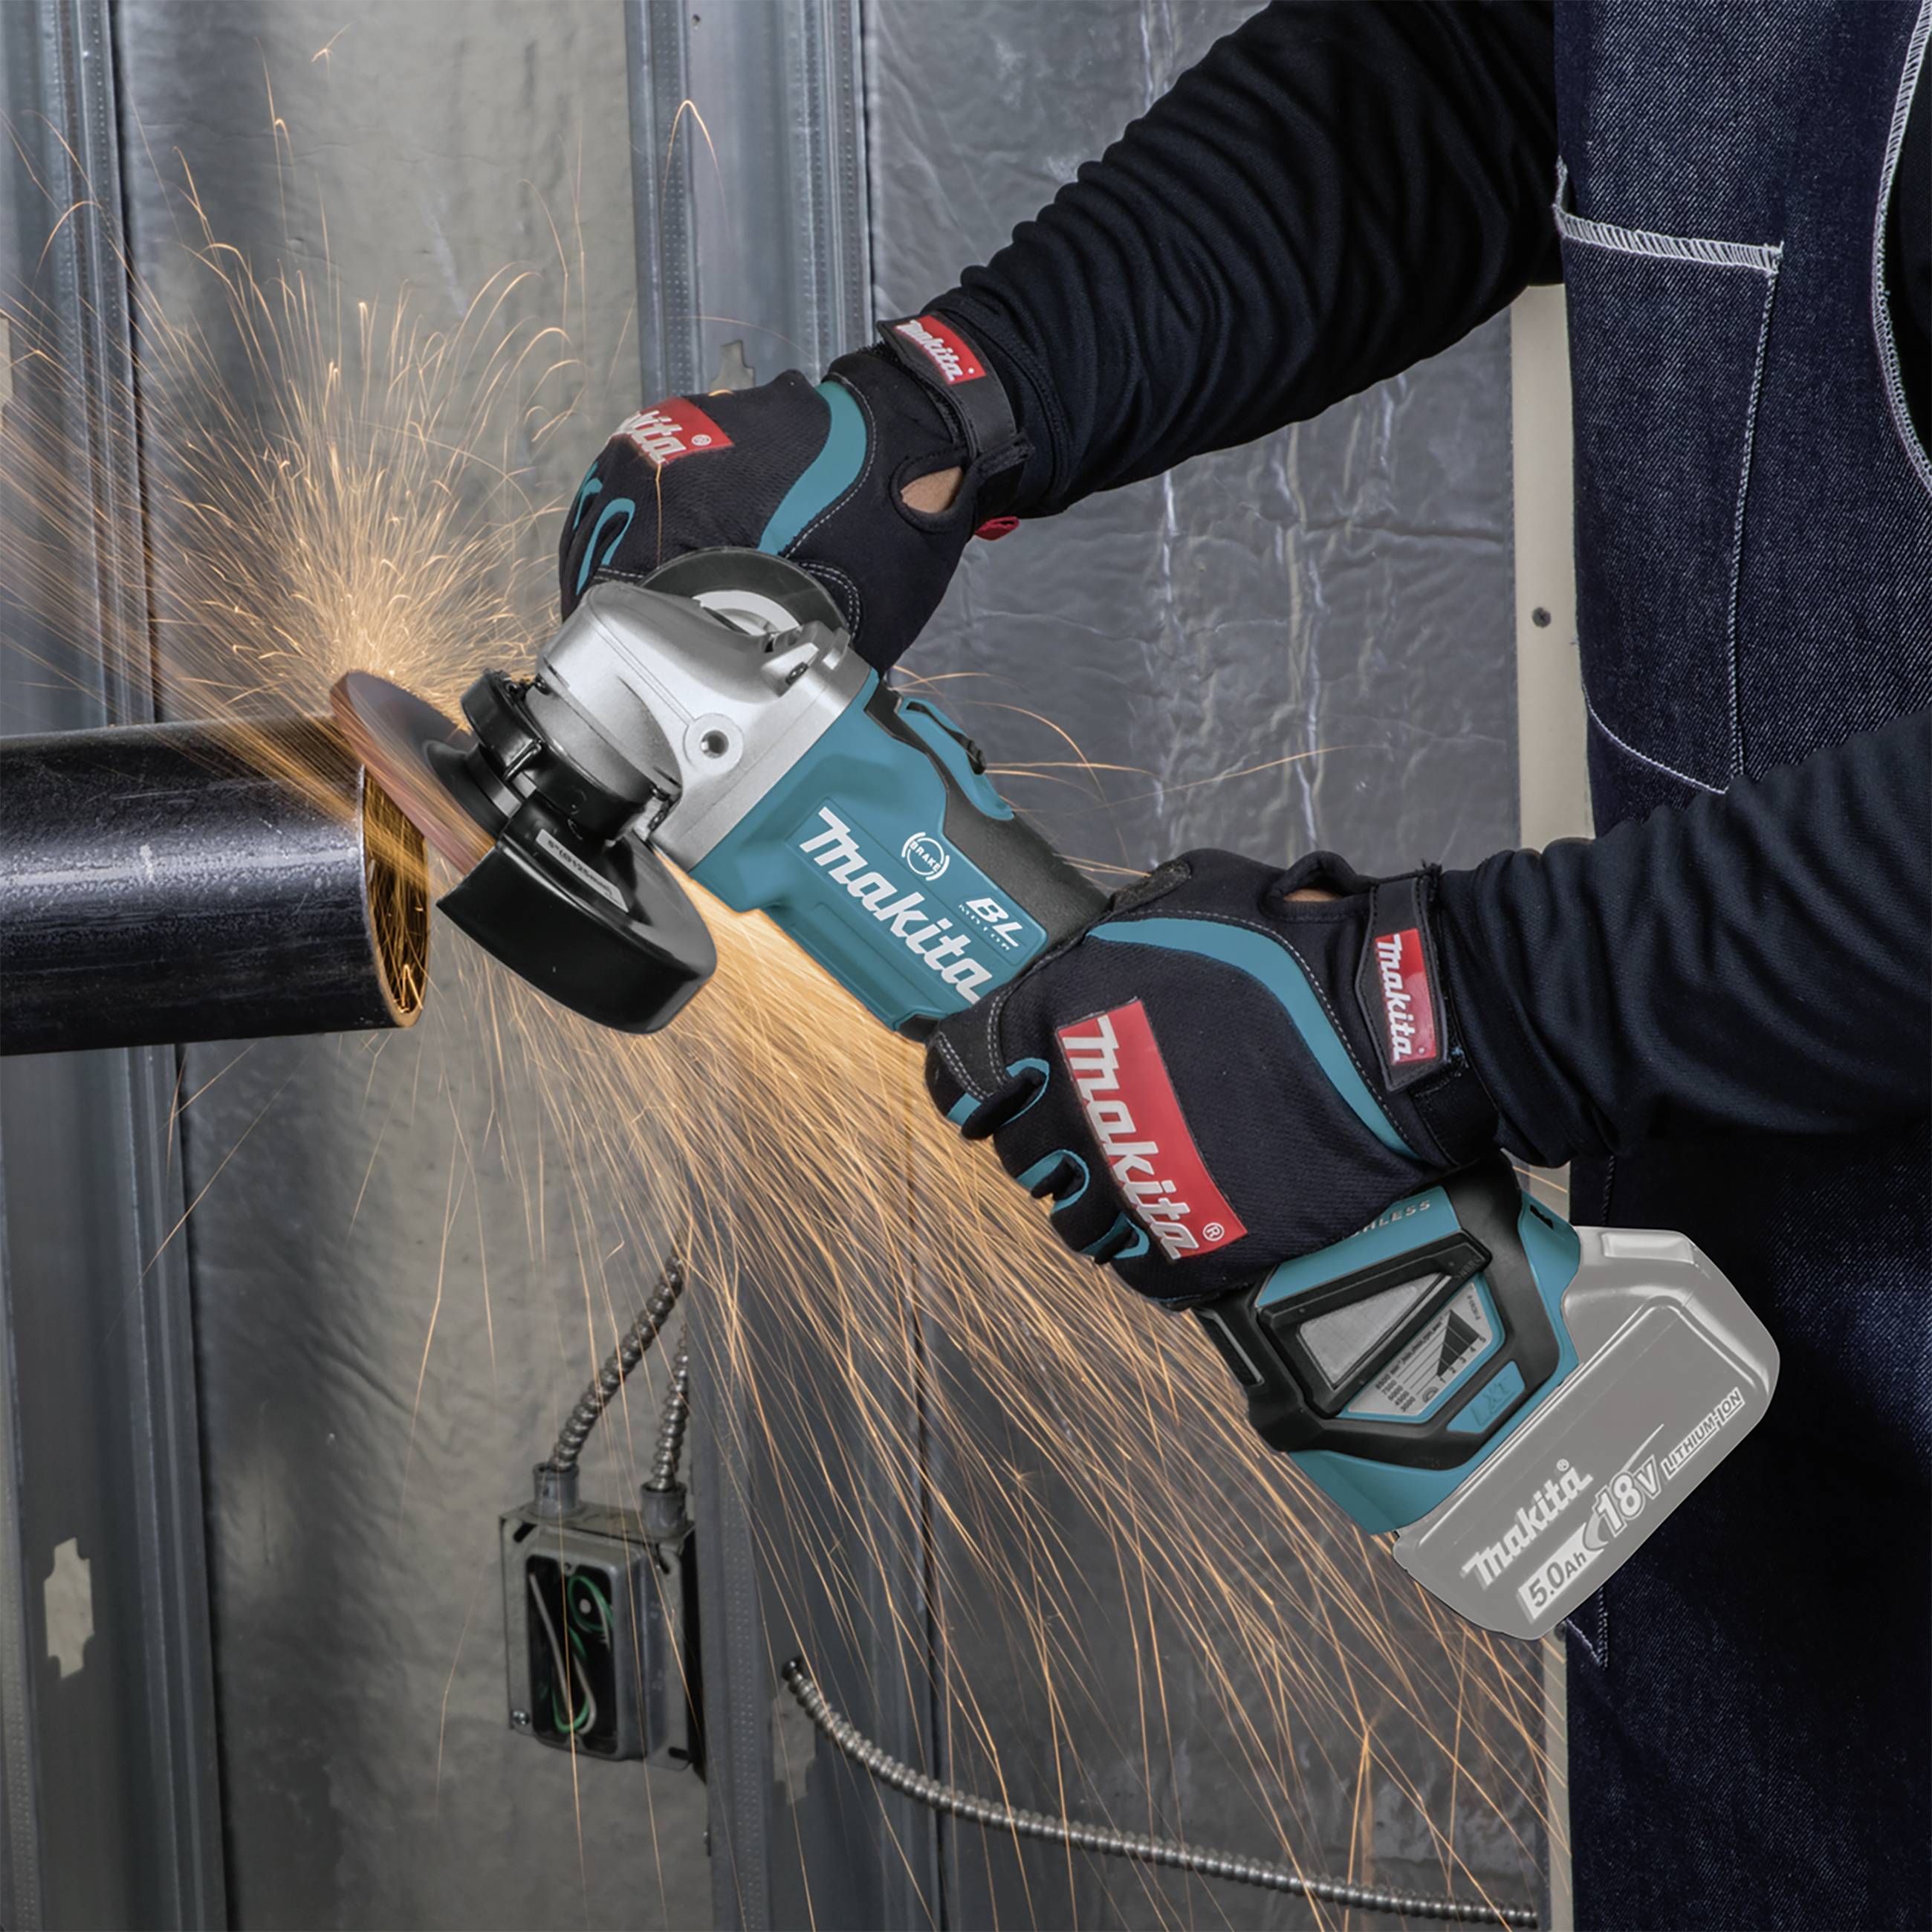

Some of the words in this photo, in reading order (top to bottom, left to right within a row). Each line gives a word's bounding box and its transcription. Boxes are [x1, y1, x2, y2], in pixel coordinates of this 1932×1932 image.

[910, 841, 941, 872] BRAKE
[800, 806, 993, 1004] makita
[965, 898, 1023, 947] BL
[1062, 1014, 1199, 1260] makita
[1460, 1467, 1593, 1591] makita
[1529, 1551, 1587, 1608] 5.0Ah
